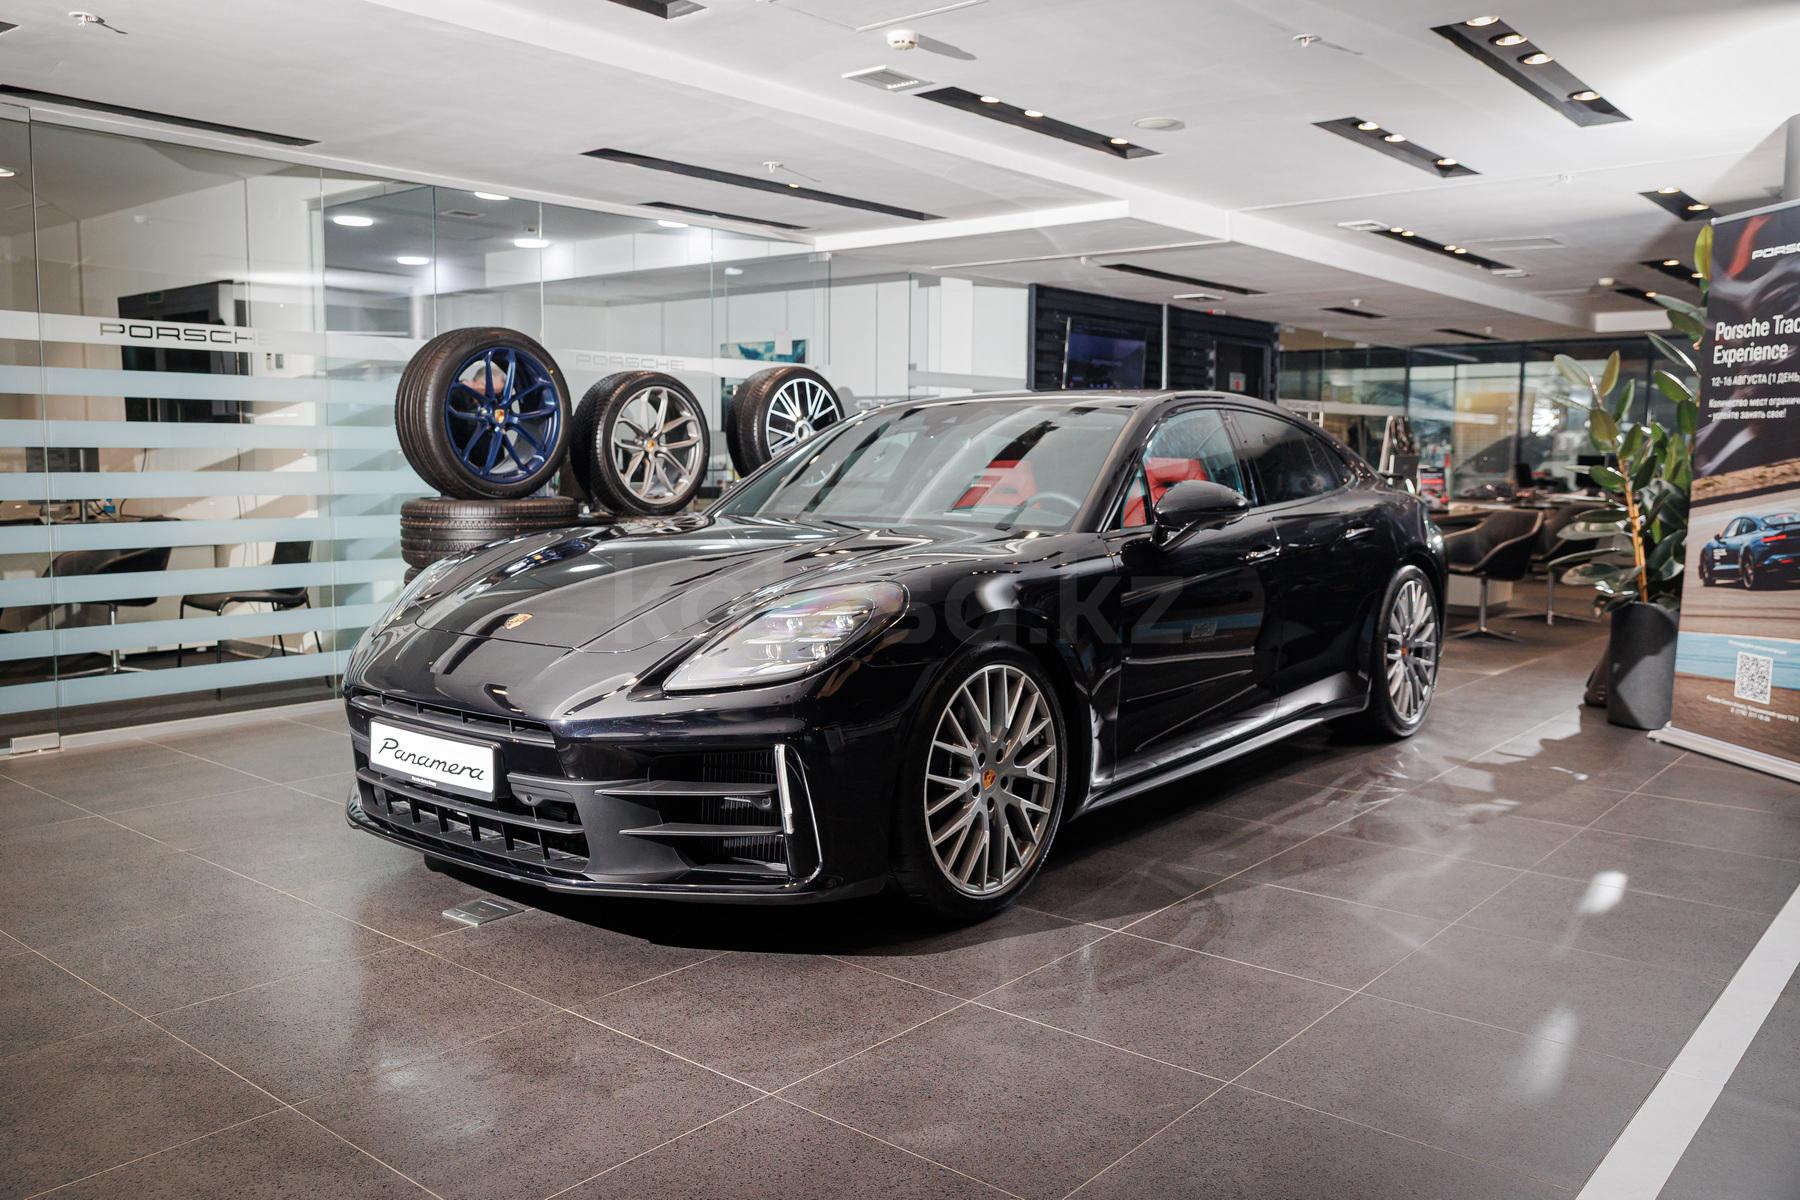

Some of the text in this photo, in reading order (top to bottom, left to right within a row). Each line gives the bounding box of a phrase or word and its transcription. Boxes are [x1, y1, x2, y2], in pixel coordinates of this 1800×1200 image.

[1715, 314, 1800, 341] Porsche Trac
[576, 353, 685, 370] PORSCHE
[1713, 341, 1789, 368] Experience
[1732, 374, 1768, 386] АВГУСТА
[379, 737, 485, 781] Panamera
